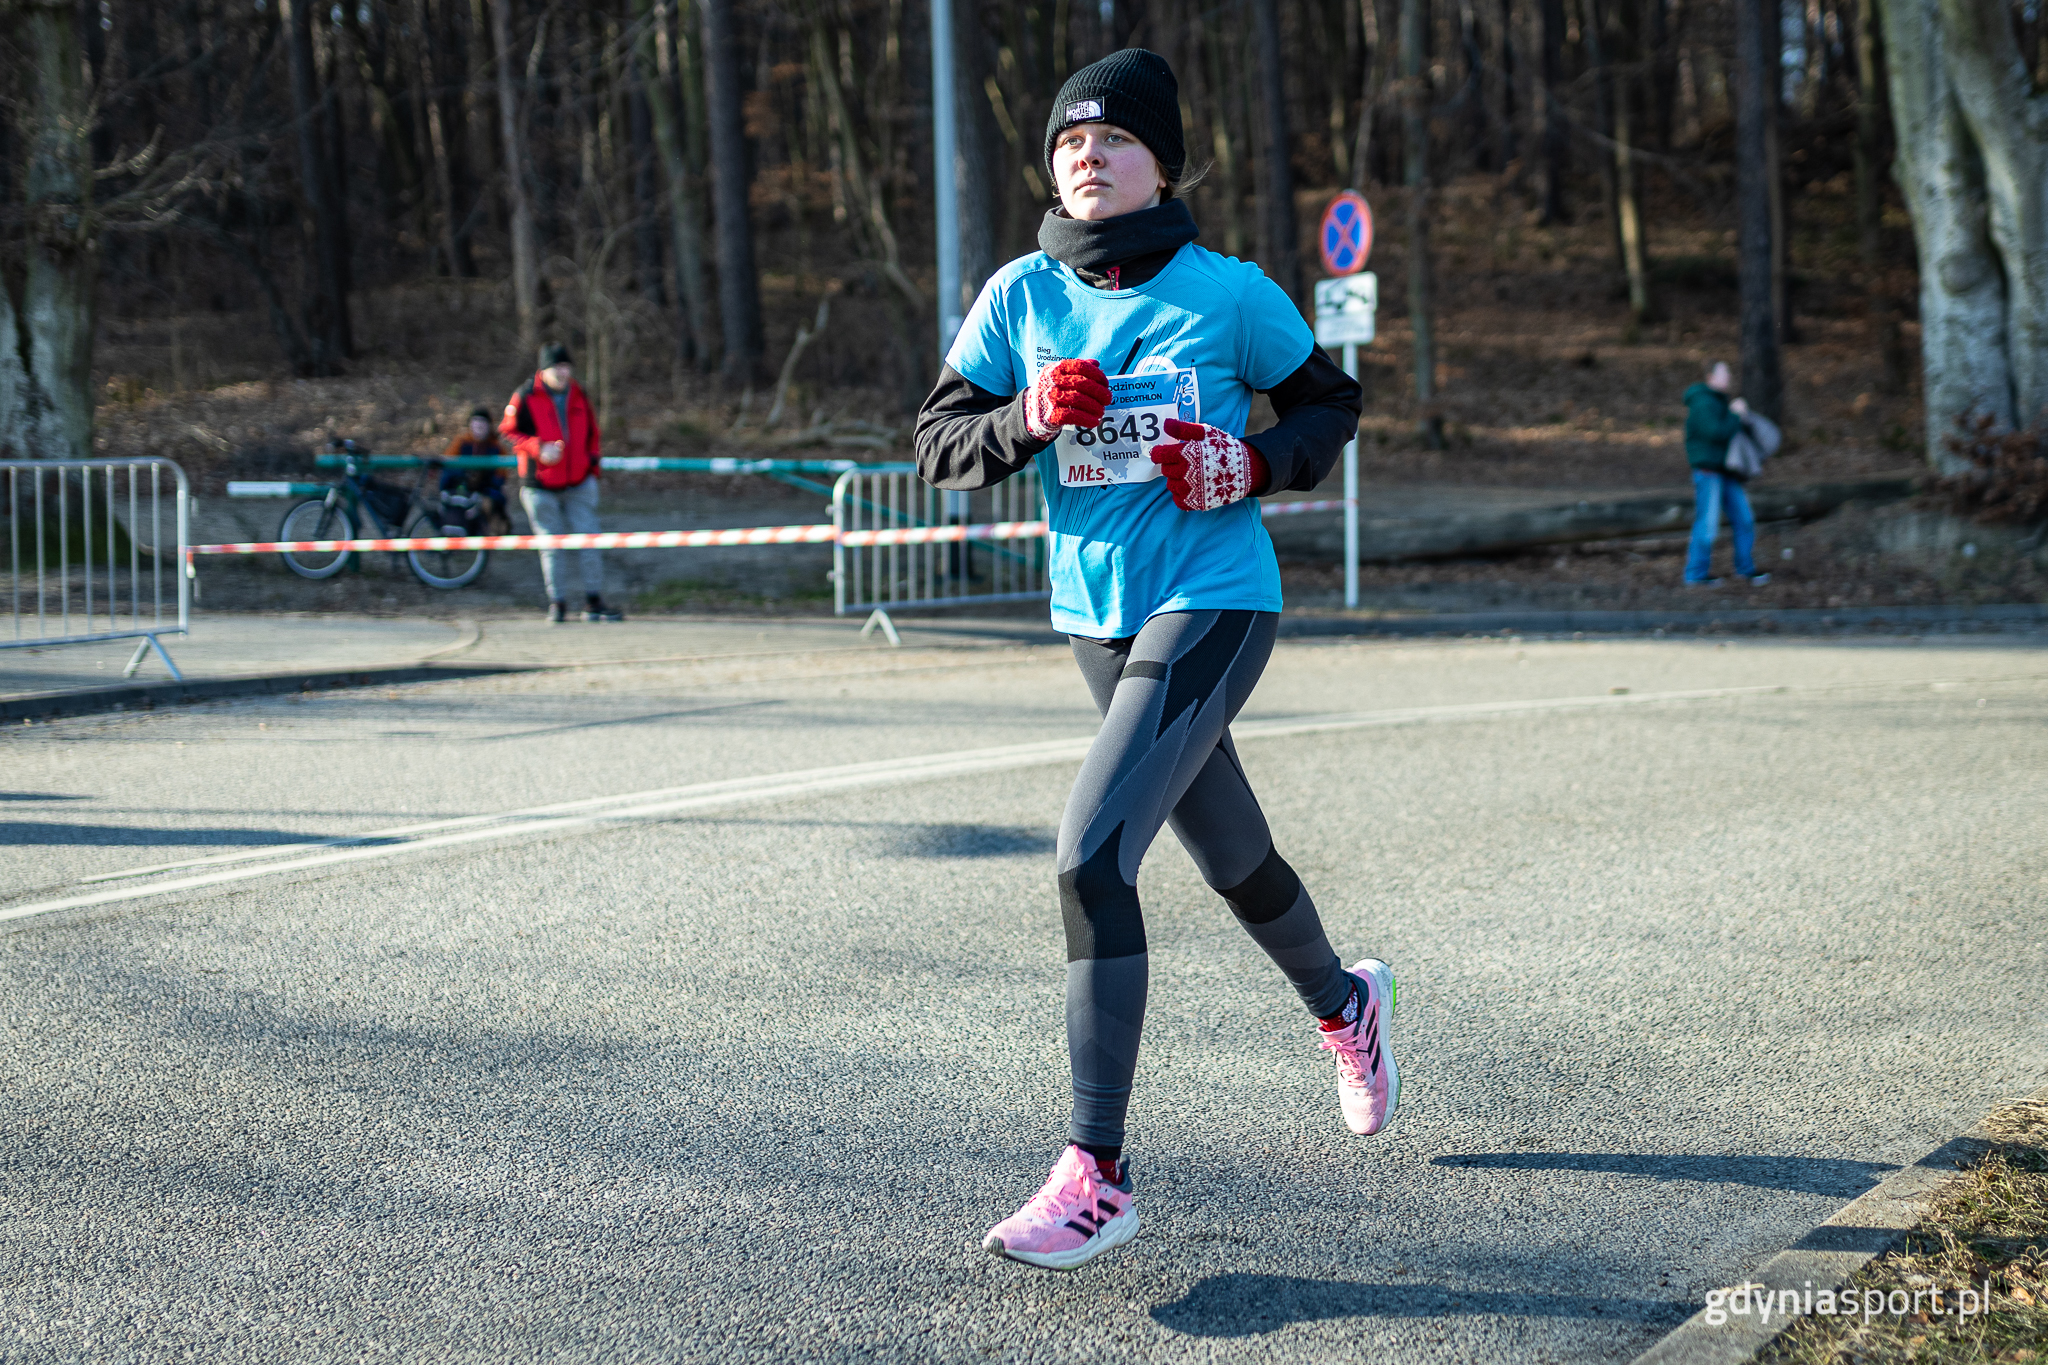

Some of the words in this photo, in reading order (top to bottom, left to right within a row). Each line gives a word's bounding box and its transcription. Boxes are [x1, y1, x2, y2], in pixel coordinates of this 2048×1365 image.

[1077, 101, 1089, 109] THE
[1066, 107, 1088, 117] NORTH
[1073, 112, 1089, 121] FACE
[1036, 346, 1051, 354] Bieg
[1108, 381, 1156, 392] odzinowy
[1119, 393, 1162, 403] DECATHLON
[1076, 412, 1160, 446] 8643
[1103, 450, 1140, 461] Hanna
[1067, 464, 1105, 483] MŁs
